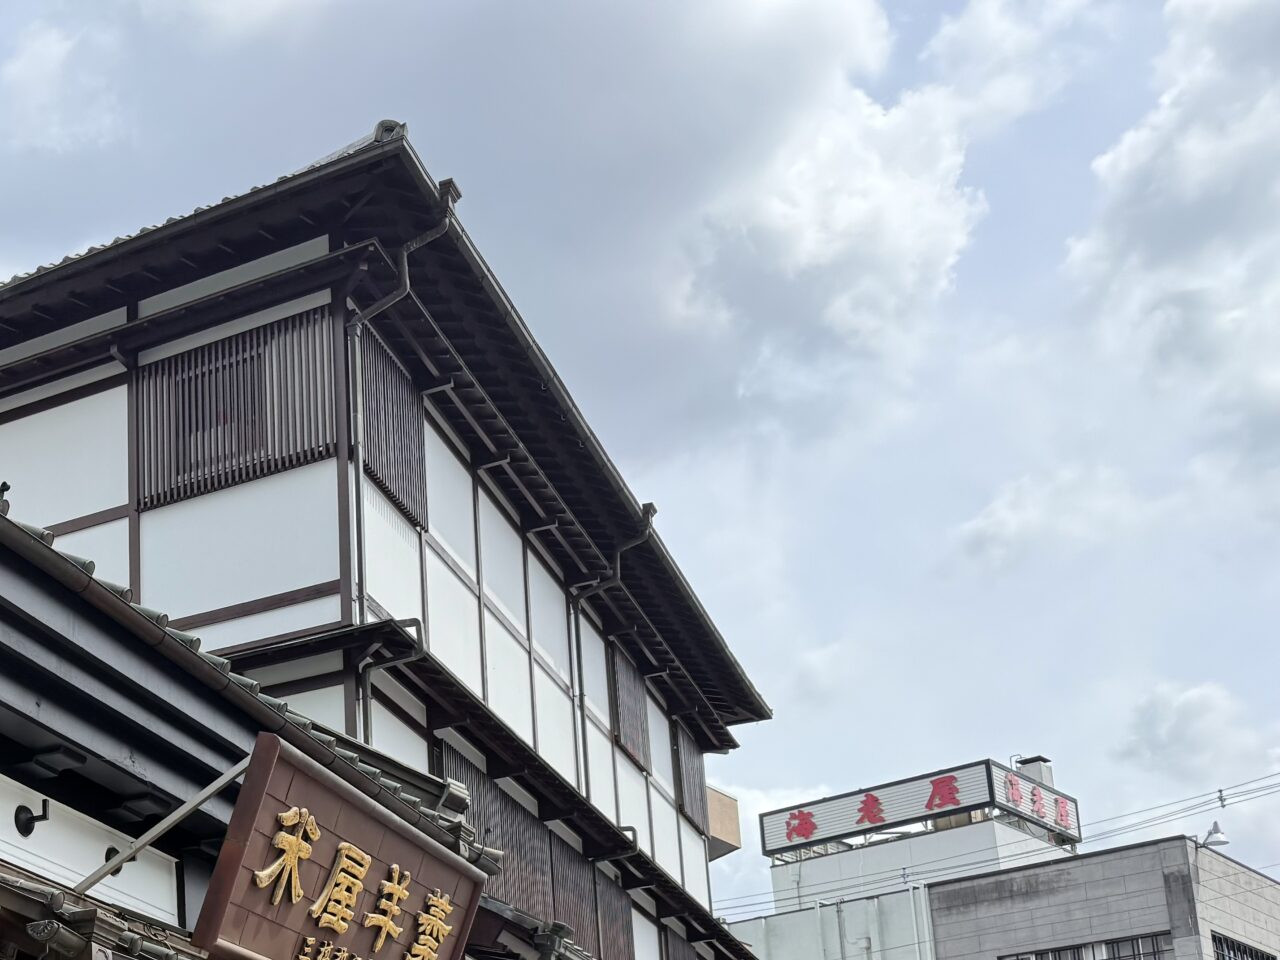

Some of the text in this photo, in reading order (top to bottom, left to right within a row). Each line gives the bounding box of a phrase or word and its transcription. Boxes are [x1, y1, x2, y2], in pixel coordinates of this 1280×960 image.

[785, 775, 960, 842] 海老屋
[1006, 772, 1070, 829] 海老屋
